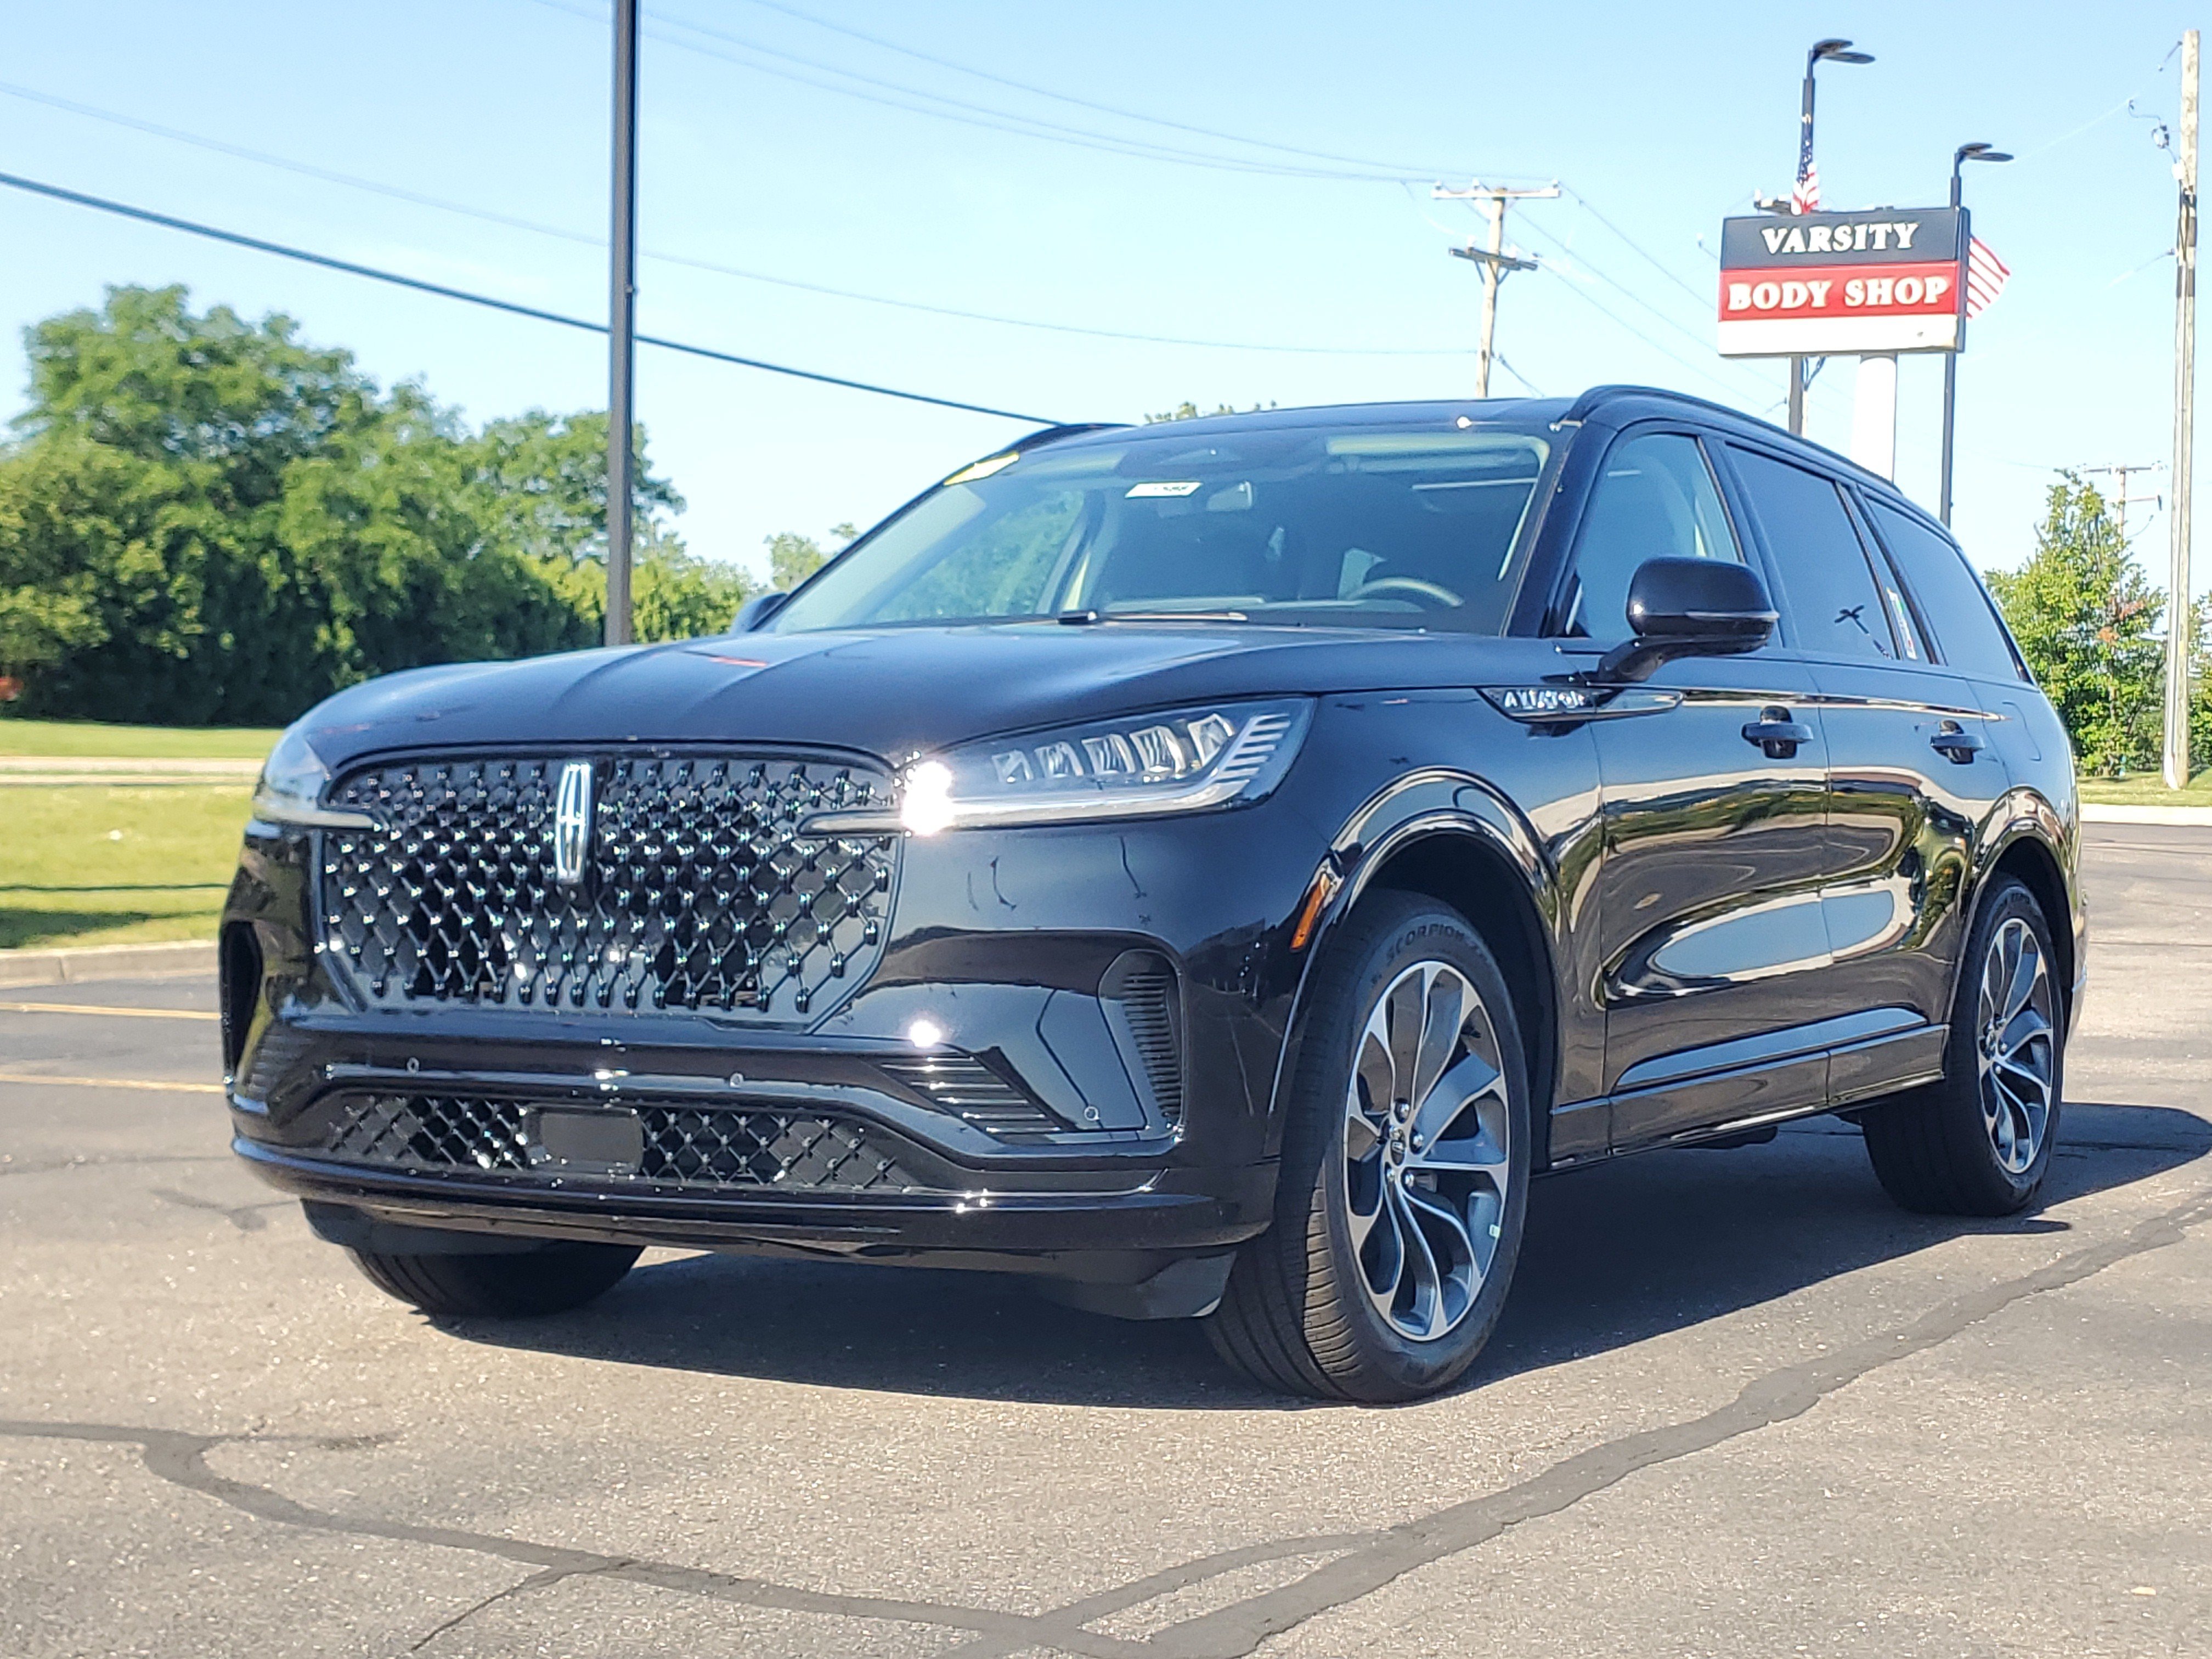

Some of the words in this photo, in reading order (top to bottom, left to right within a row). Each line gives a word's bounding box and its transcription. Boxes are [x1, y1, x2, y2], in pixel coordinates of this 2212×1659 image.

[1762, 223, 1919, 255] VARSITY
[1728, 280, 1832, 311] BODY
[1844, 277, 1949, 307] SHOP
